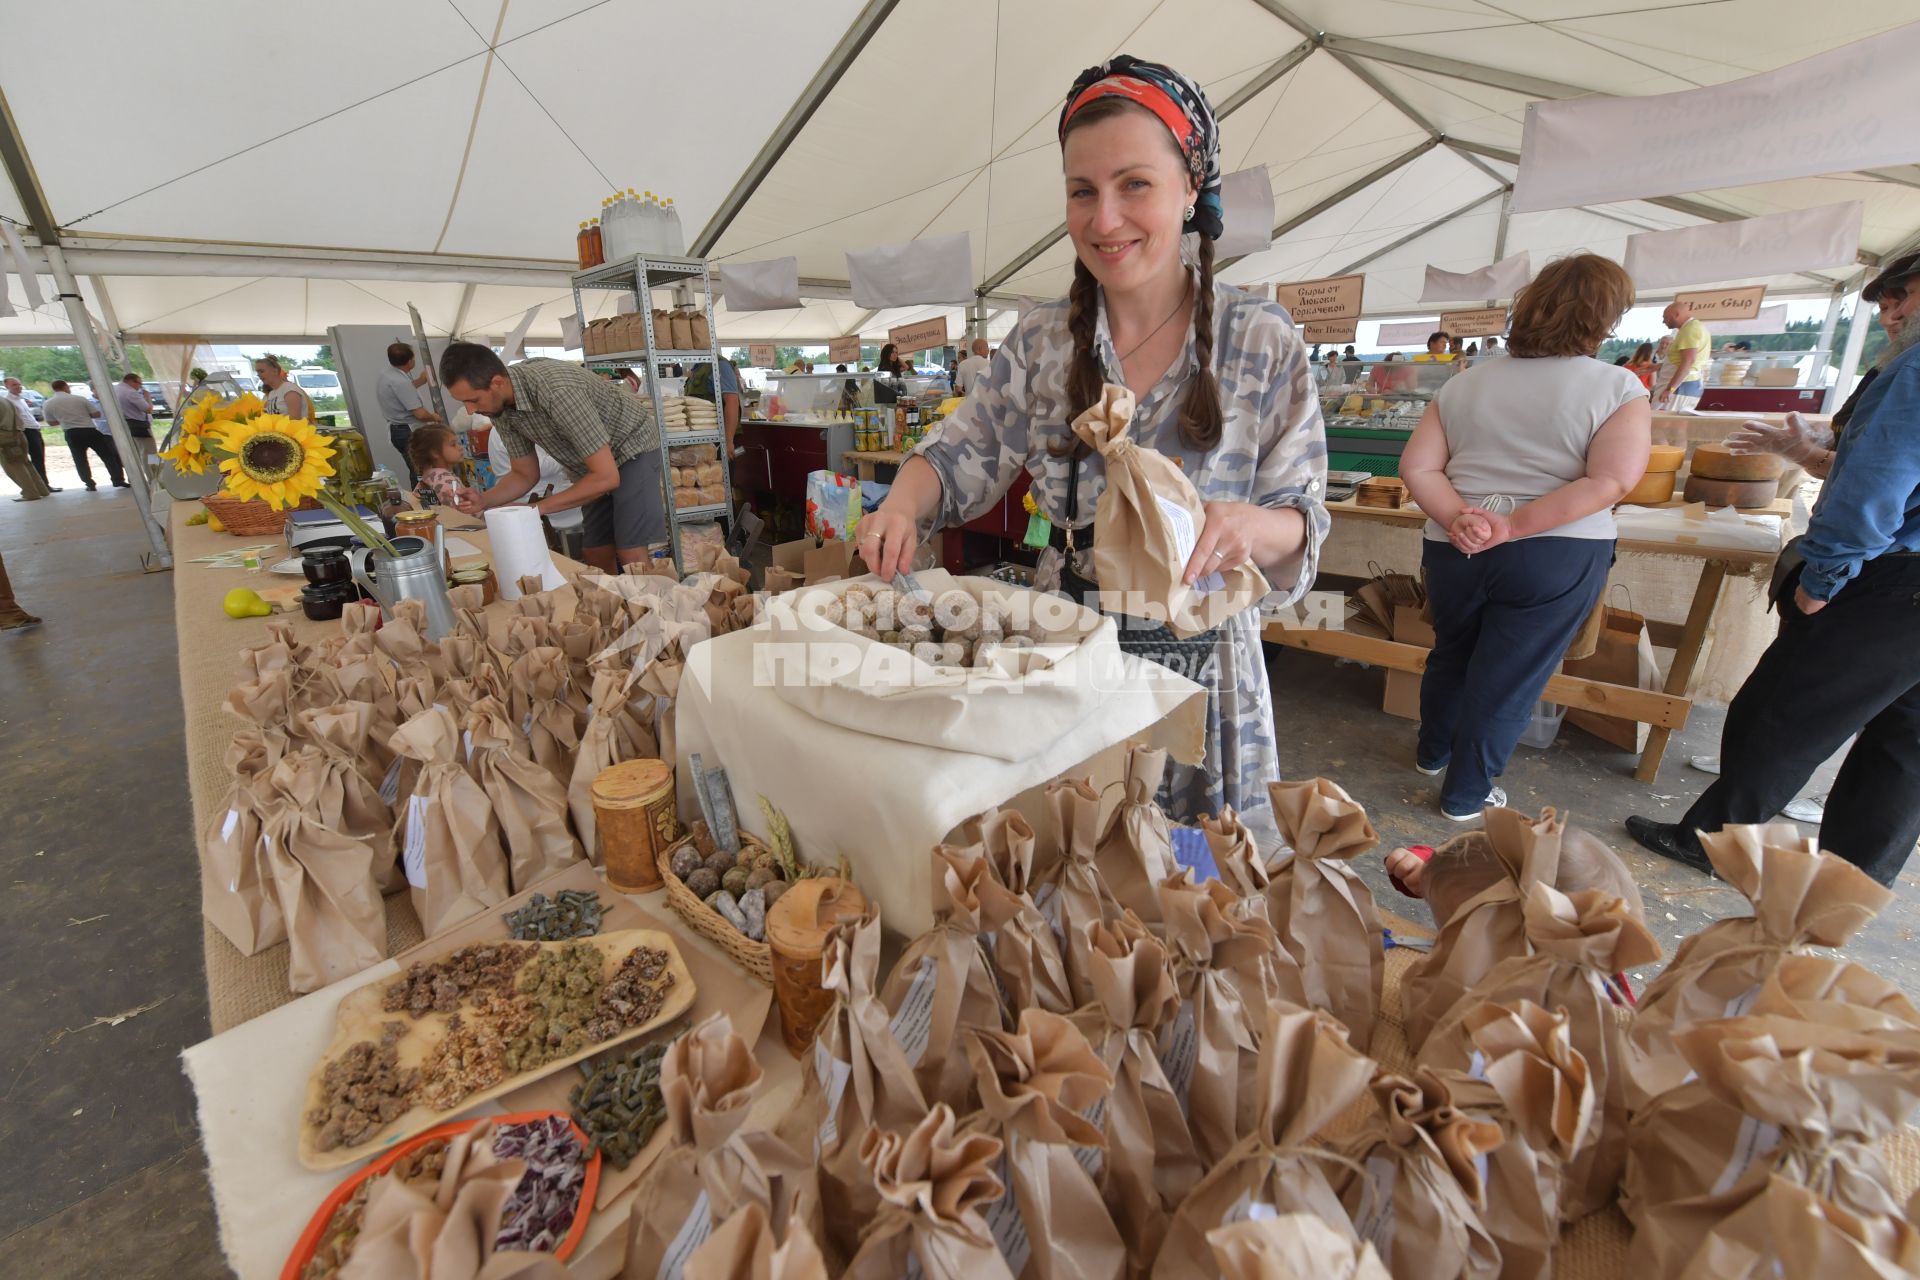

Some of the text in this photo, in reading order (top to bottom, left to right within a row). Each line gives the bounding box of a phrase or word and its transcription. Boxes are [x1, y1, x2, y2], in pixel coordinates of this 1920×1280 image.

[1298, 285, 1340, 296] Сыры от
[1299, 296, 1336, 305] Любови
[1721, 297, 1753, 310] Сыр
[1307, 325, 1354, 334] Олег Пекарь
